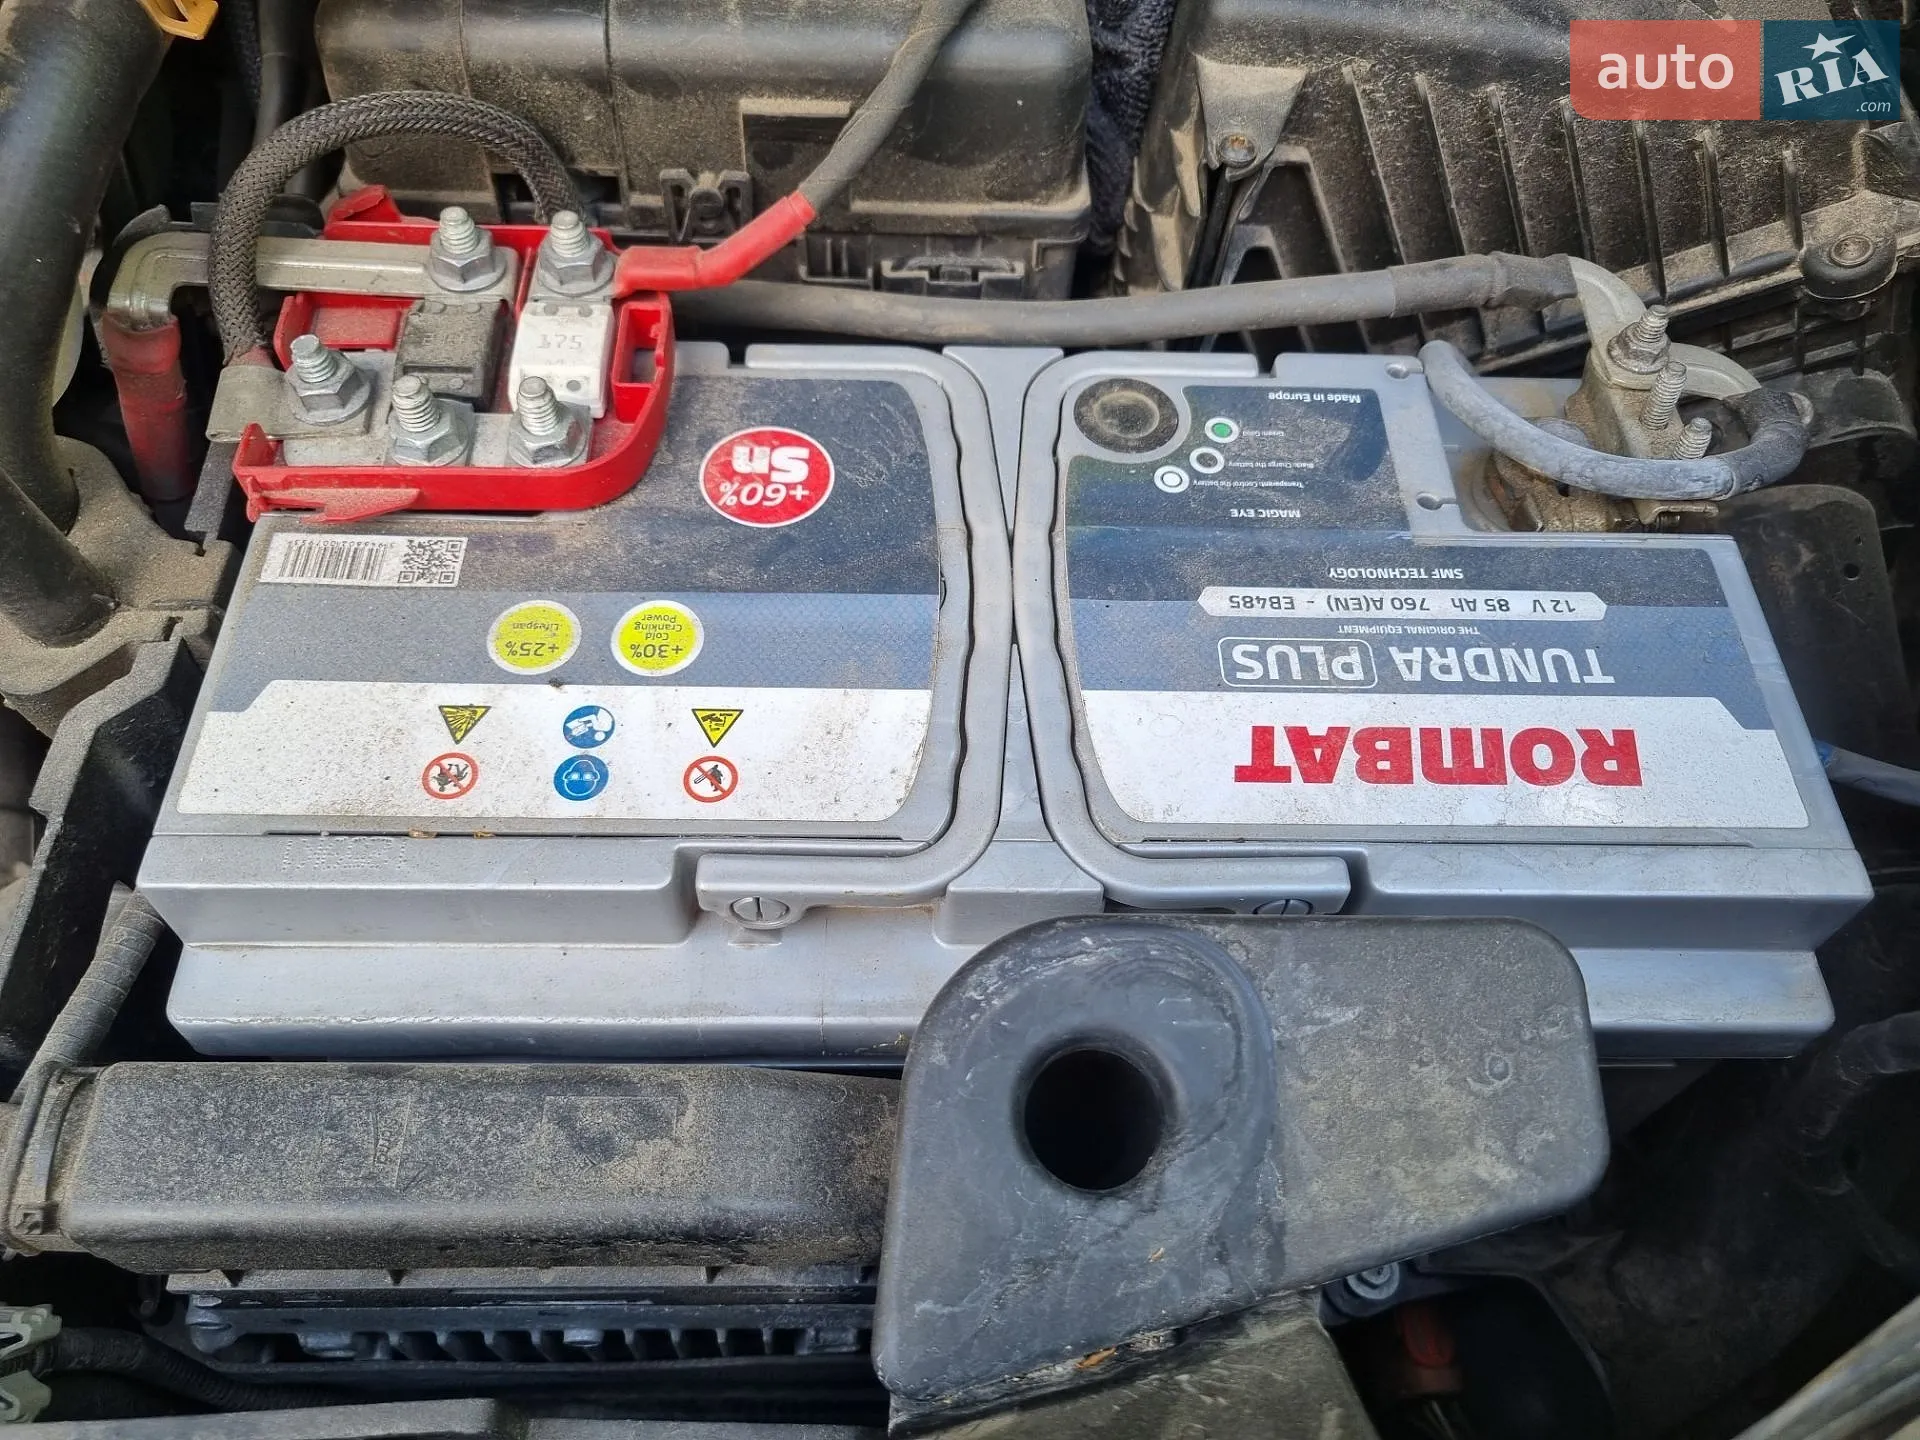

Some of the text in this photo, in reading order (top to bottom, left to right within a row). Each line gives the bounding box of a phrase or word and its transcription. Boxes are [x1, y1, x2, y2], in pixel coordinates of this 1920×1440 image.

[1268, 390, 1361, 404] Made in Europe
[1232, 479, 1258, 488] Control
[718, 481, 810, 507] +60%
[1230, 508, 1301, 518] MAGIC EYE
[1329, 567, 1465, 580] SMF TECHNOLOGY
[1229, 594, 1296, 610] EB485
[1326, 595, 1384, 612] A(EN)
[1391, 596, 1430, 611] 760
[1451, 597, 1477, 612] Ah
[1484, 598, 1510, 612] 85
[1532, 599, 1544, 613] V
[1550, 599, 1576, 613] 12
[641, 614, 677, 623] Power
[512, 621, 560, 631] Lifespan
[634, 621, 683, 632] Cranking
[1338, 624, 1480, 635] THE ORIGINAL EQUIPMENT
[645, 632, 669, 640] Cold
[505, 641, 560, 657] +25%
[630, 643, 684, 659] +30%
[1232, 643, 1616, 684] TUNDRA PLUS
[1234, 725, 1641, 788] ROMBAT
